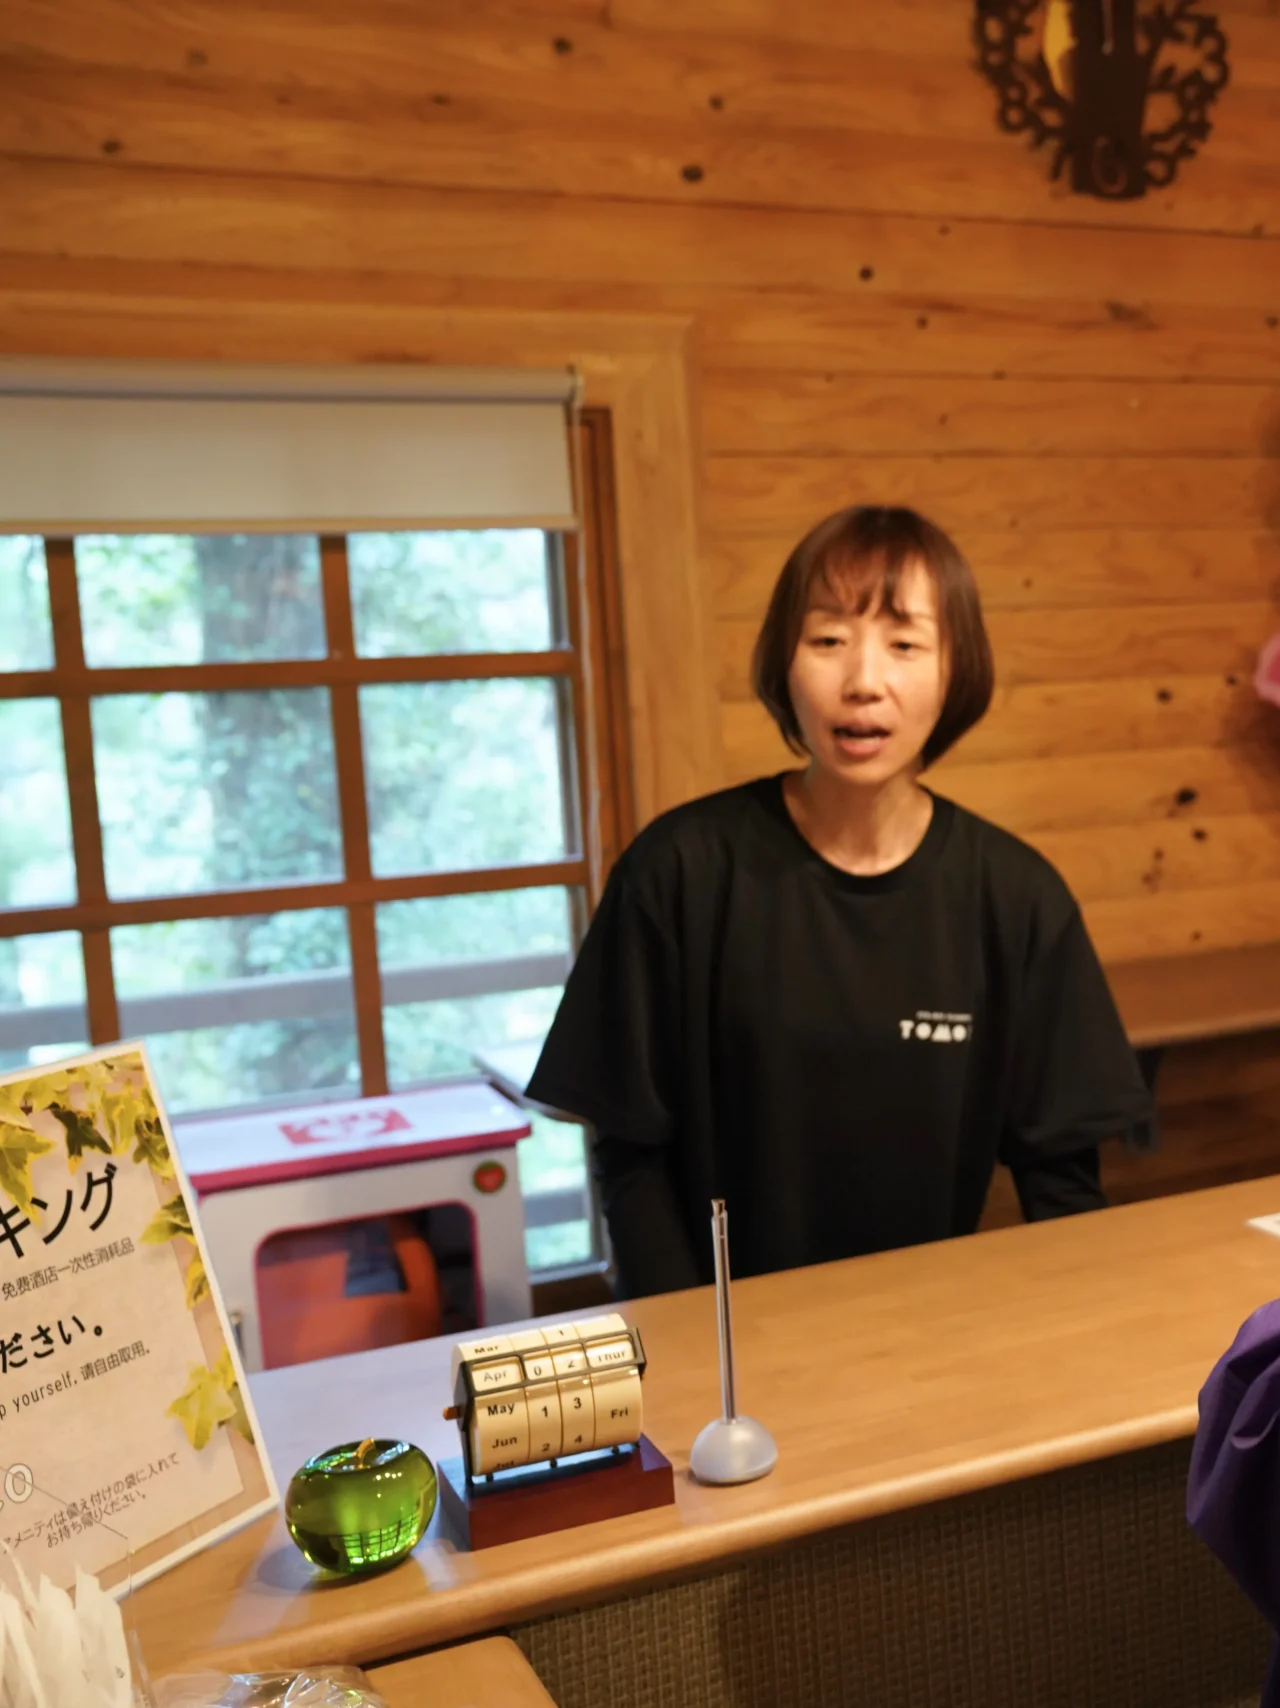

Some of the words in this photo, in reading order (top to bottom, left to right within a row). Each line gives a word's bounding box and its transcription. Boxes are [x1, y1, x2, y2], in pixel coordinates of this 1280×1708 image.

[0, 1162, 117, 1258] キング
[1, 1236, 135, 1300] 免费酒店一次性消耗品
[0, 1315, 103, 1373] ださい。
[12, 1371, 78, 1414] yourself.
[483, 1368, 508, 1383] Apr
[487, 1401, 516, 1416] May
[541, 1406, 549, 1418] 1
[573, 1397, 582, 1409] 3
[611, 1406, 629, 1419] Fri
[492, 1436, 517, 1449] Jun
[542, 1443, 550, 1452] 2
[574, 1434, 583, 1444] 4
